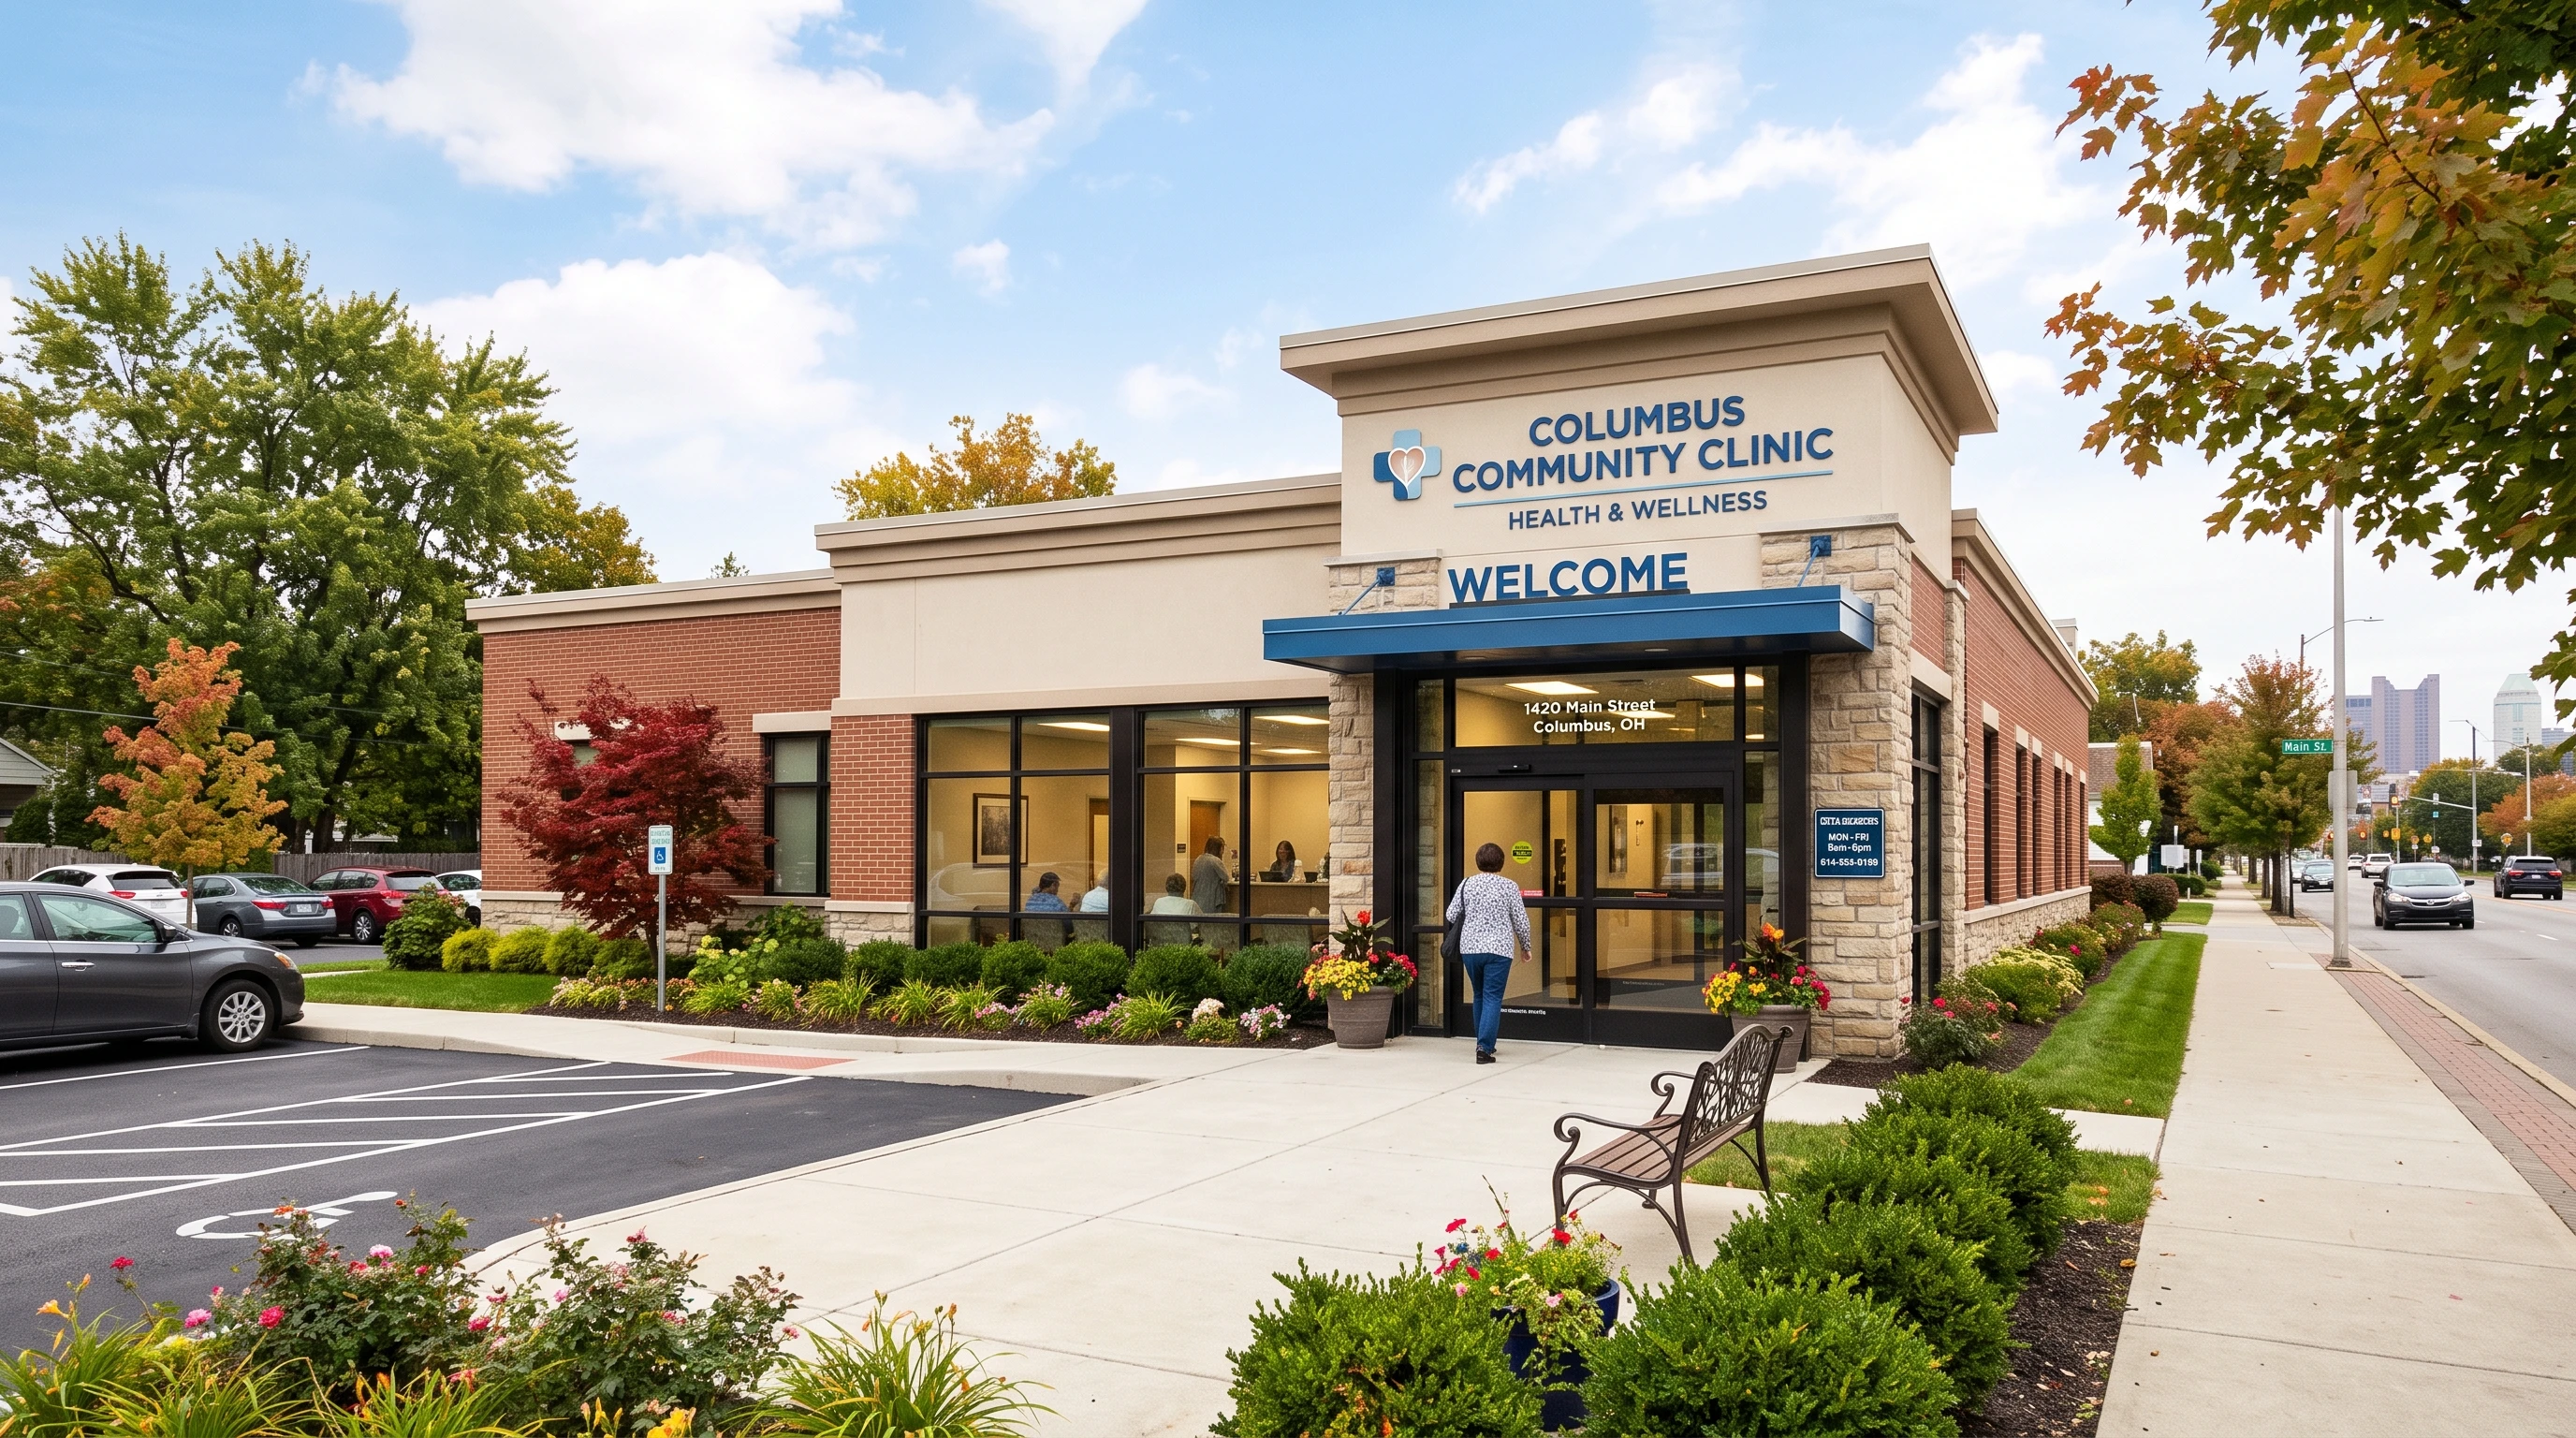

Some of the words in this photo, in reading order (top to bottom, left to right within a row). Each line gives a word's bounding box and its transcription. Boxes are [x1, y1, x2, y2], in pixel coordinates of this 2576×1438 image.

[1529, 395, 1745, 447] COLUMBUS
[1452, 442, 1686, 492] COMMUNITY
[1697, 427, 1834, 470] CLINIC
[1509, 505, 1601, 530] HEALTH
[1607, 503, 1625, 522] &
[1632, 490, 1768, 520] WELLNESS
[1448, 552, 1688, 605] WELCOME
[1524, 701, 1561, 715] 1420
[1566, 700, 1603, 714] Main
[1607, 698, 1656, 712] Street
[1533, 718, 1616, 734] Columbus,
[1620, 717, 1646, 731] OH
[2285, 741, 2309, 752] Main
[1852, 843, 1872, 854] 6pm
